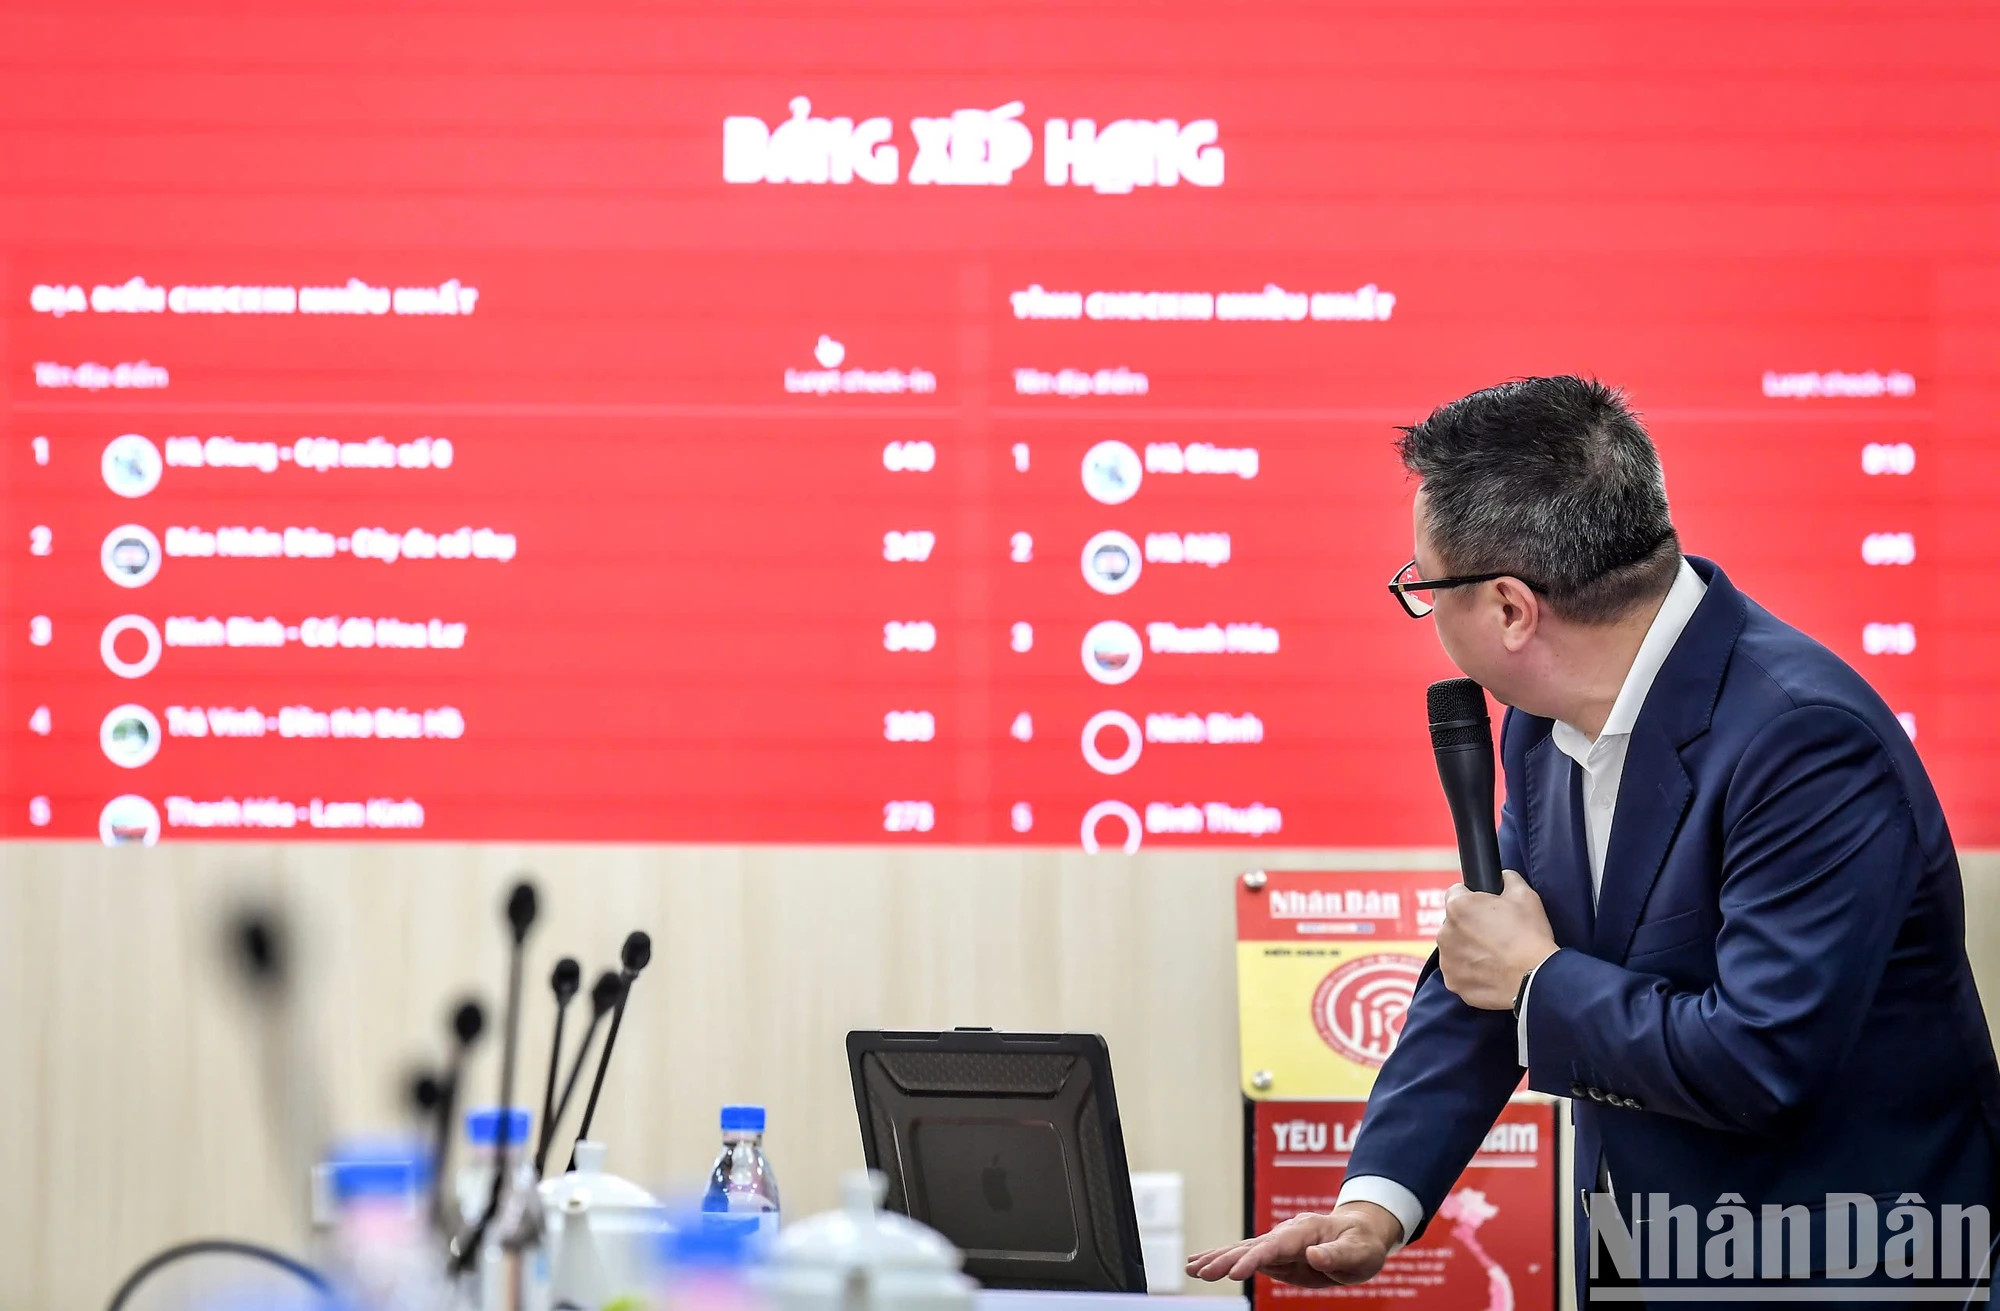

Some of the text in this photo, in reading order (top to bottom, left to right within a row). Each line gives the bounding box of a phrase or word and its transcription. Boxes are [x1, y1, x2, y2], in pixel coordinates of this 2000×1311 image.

[723, 97, 1224, 193] BẢNG XẾP HẠNG
[31, 526, 52, 555] 2
[1012, 533, 1032, 562] 2
[1269, 889, 1400, 915] Nhân Dân
[1272, 1119, 1327, 1152] YÊU
